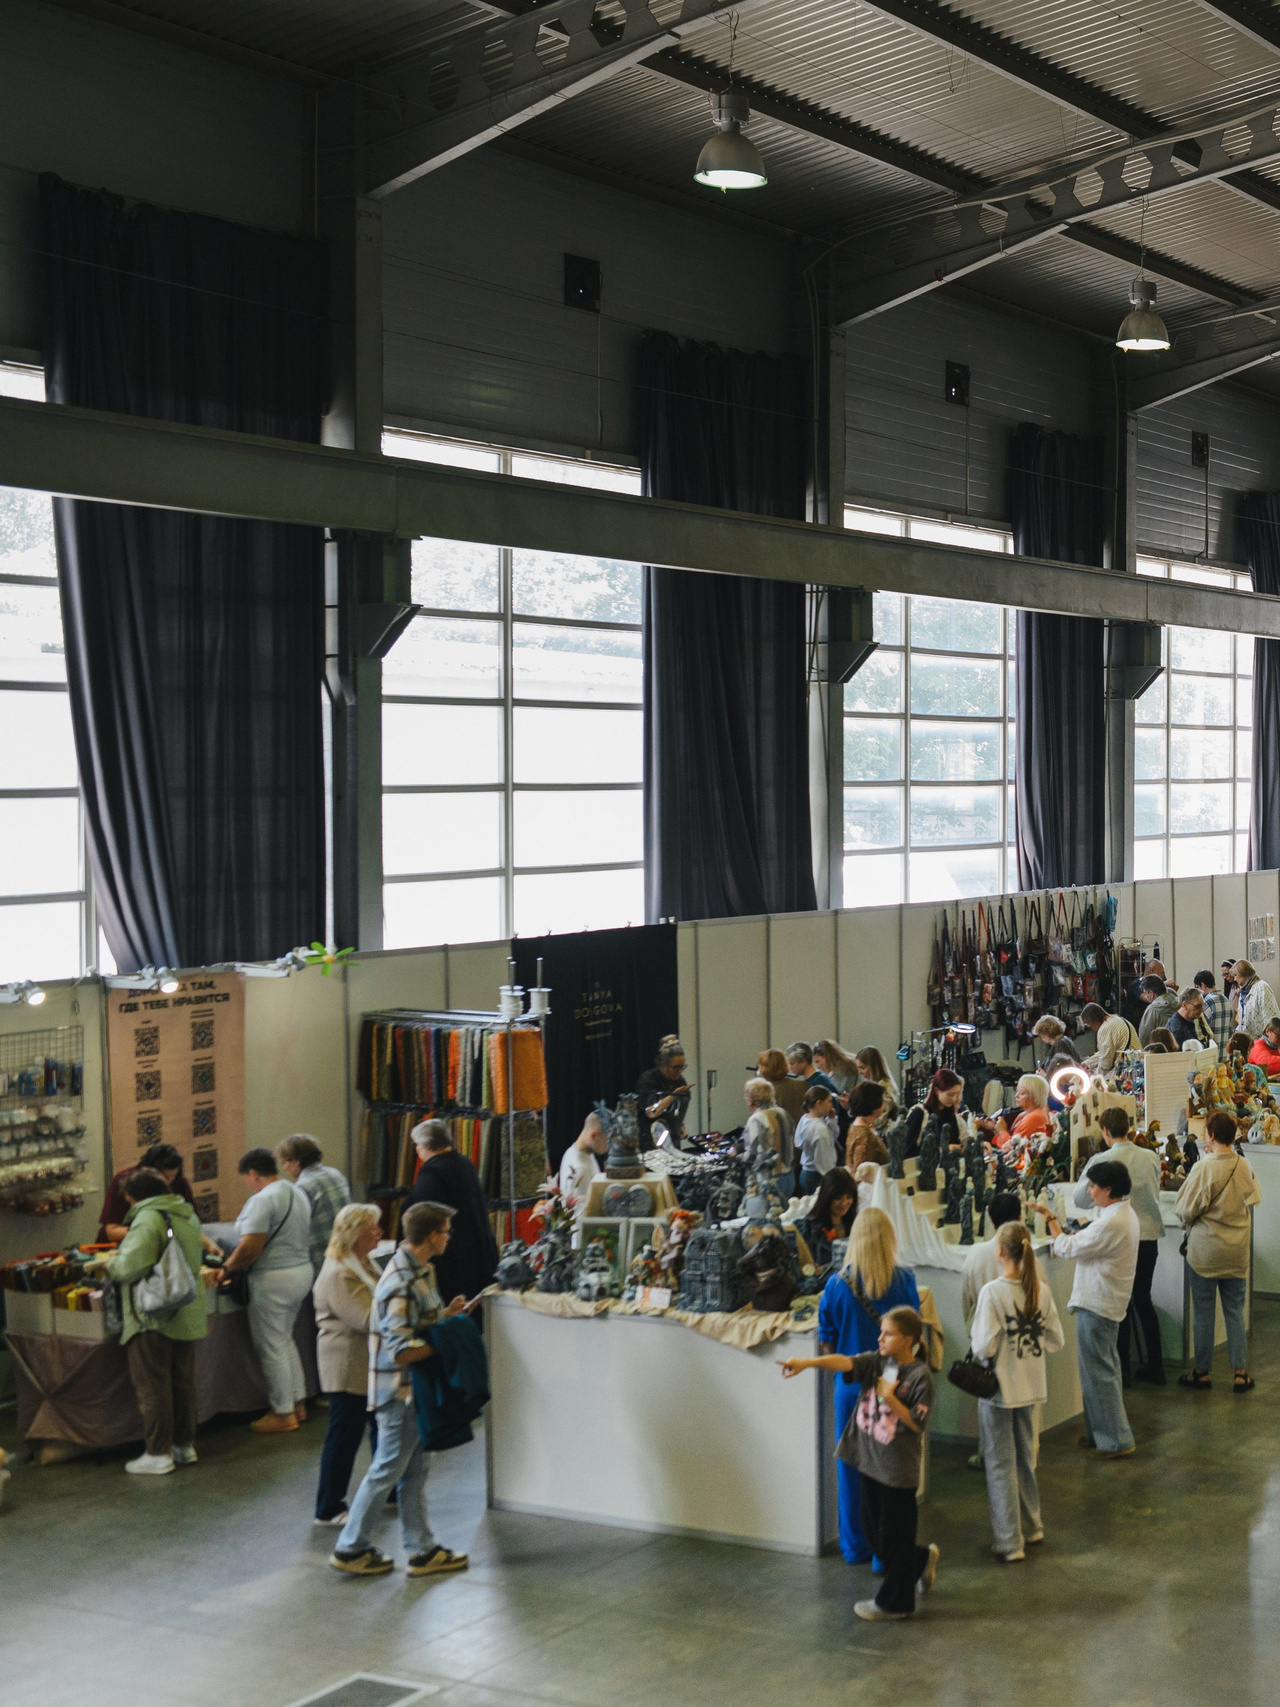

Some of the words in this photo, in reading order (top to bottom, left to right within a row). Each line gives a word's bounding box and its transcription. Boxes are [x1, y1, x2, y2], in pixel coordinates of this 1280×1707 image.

[119, 1002, 140, 1014] ГДЕ
[141, 999, 170, 1011] ТЕБЕ
[172, 993, 230, 1007] НРАВИТСЯ
[574, 1003, 623, 1019] DOGOVA
